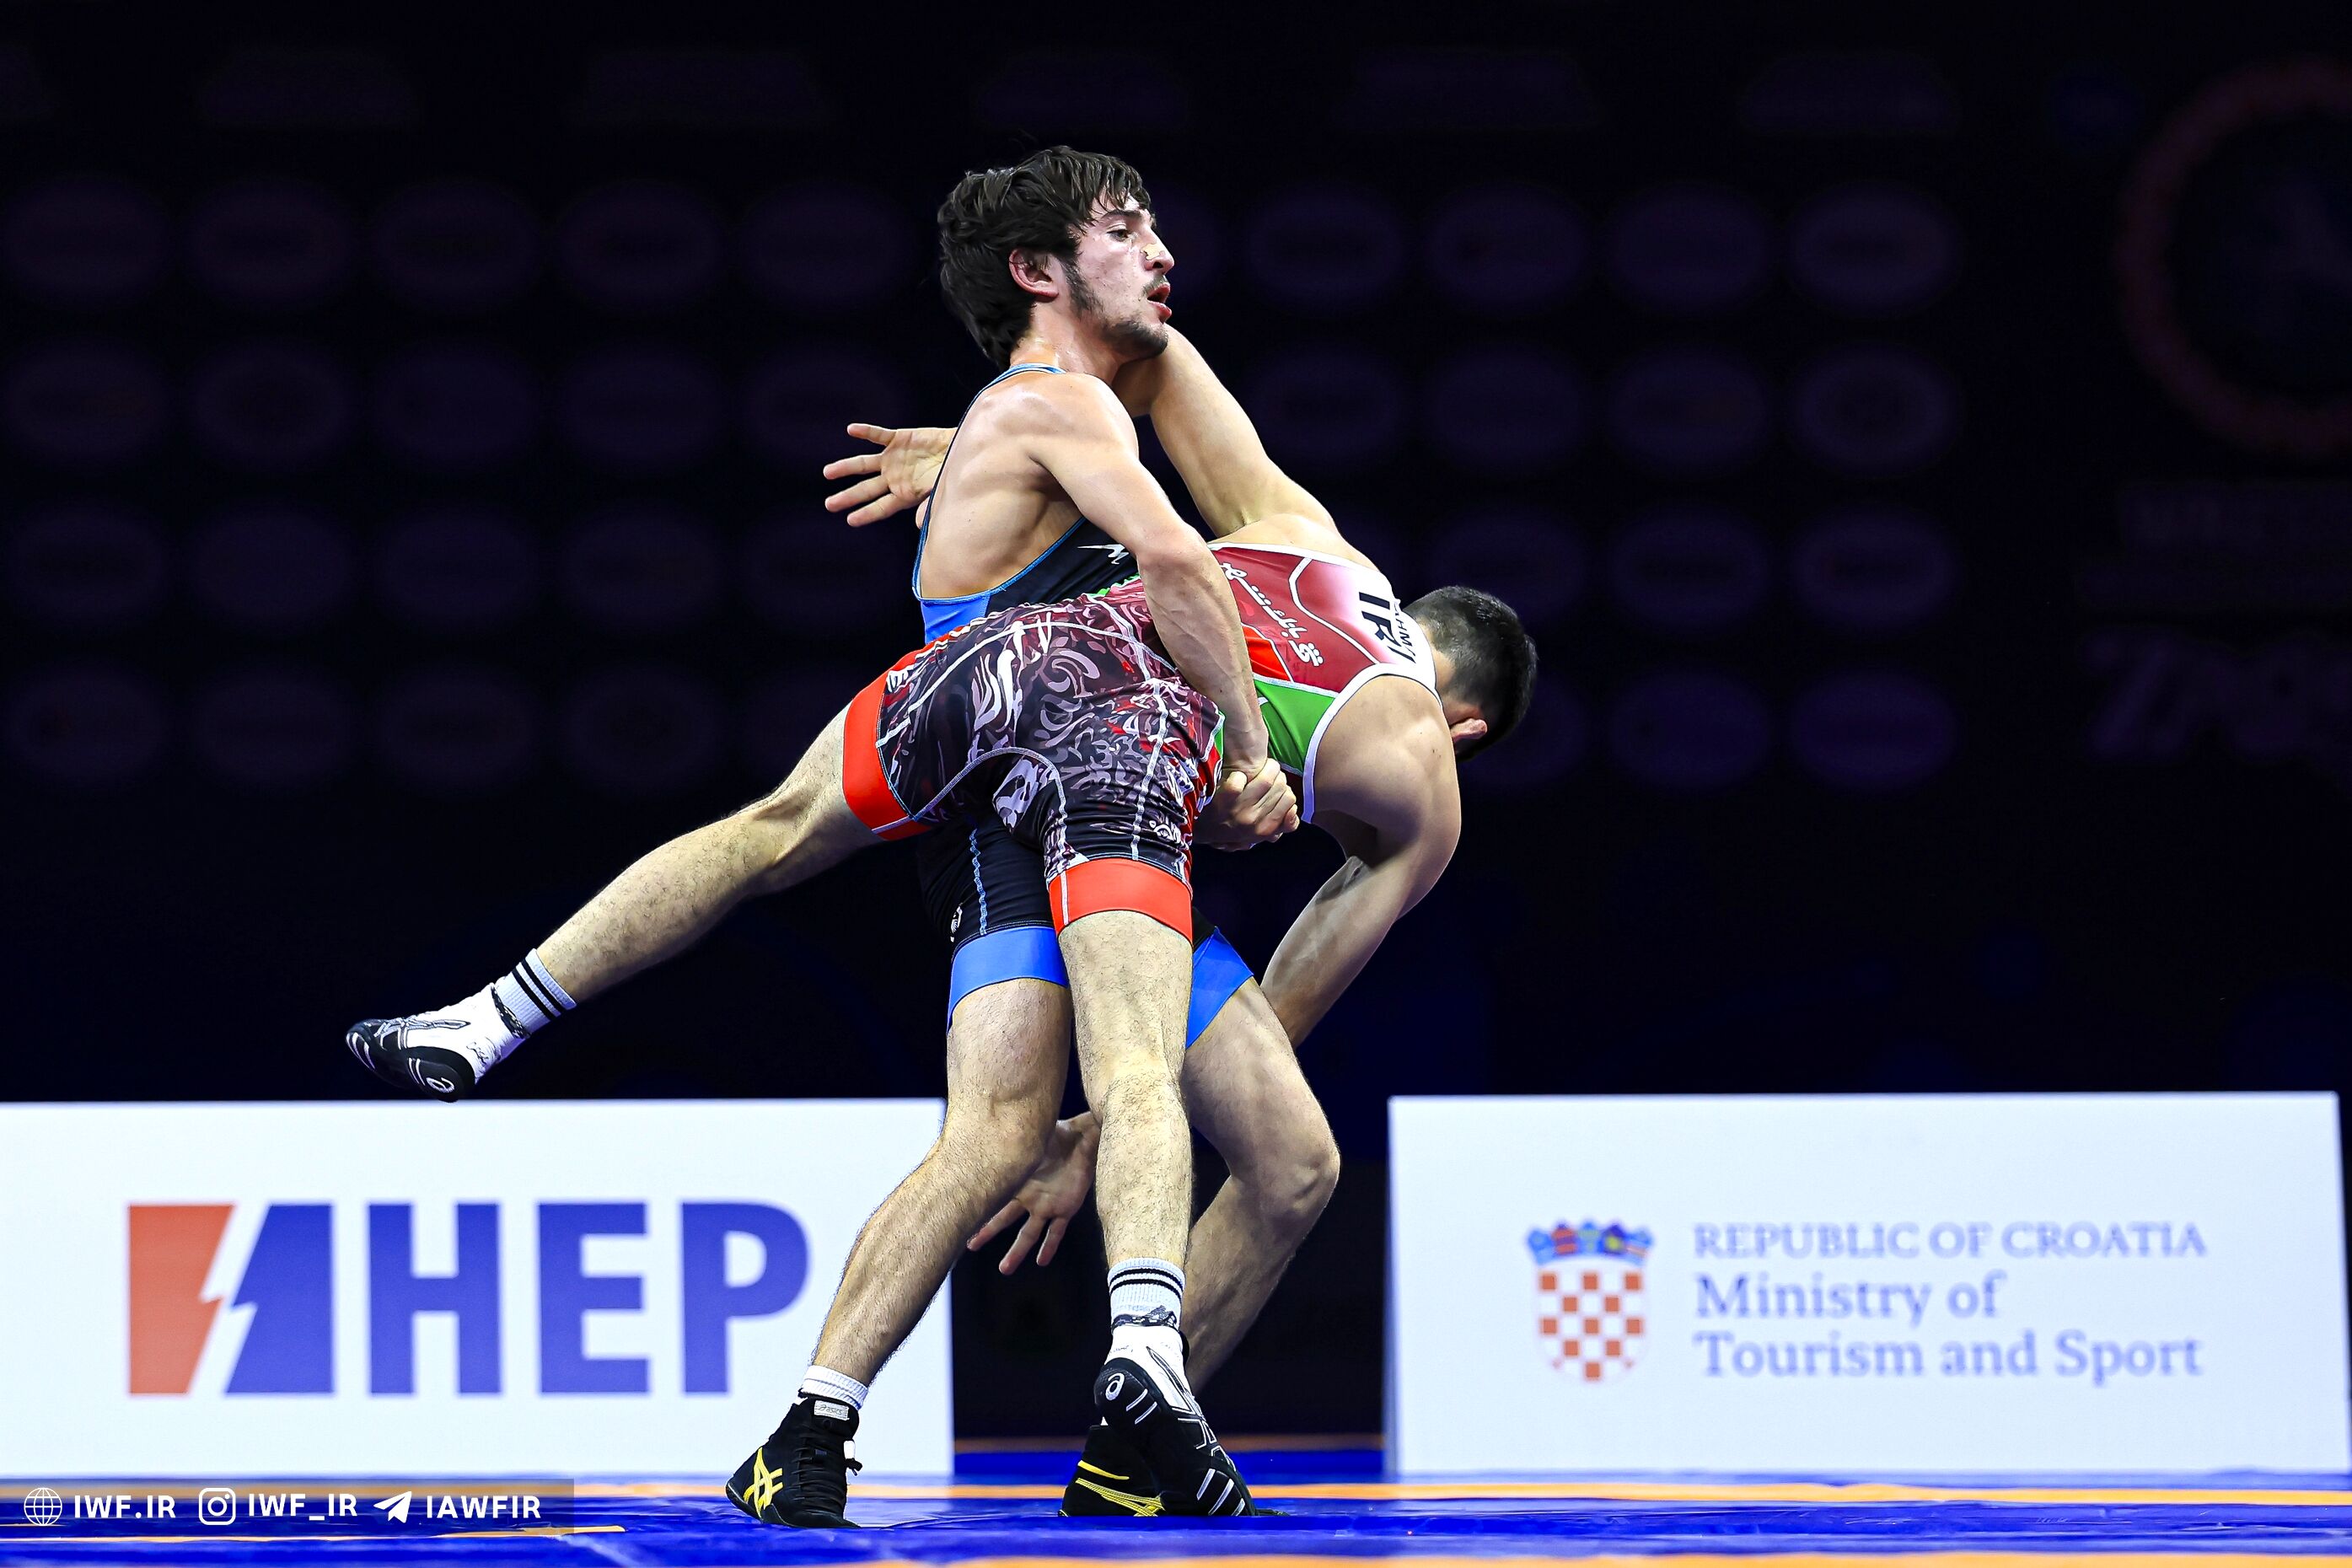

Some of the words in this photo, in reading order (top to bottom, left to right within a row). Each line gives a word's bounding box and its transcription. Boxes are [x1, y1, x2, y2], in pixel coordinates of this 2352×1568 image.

[1694, 1222, 1919, 1258] REPUBLIC
[1928, 1222, 1992, 1258] OF
[2000, 1221, 2207, 1258] CROATIA
[368, 1202, 809, 1395] HEP
[1694, 1271, 1932, 1328] Ministry
[1946, 1269, 2007, 1318] of
[1692, 1329, 1925, 1377] Tourism
[1940, 1329, 2039, 1377] and
[2054, 1329, 2203, 1388] Sport
